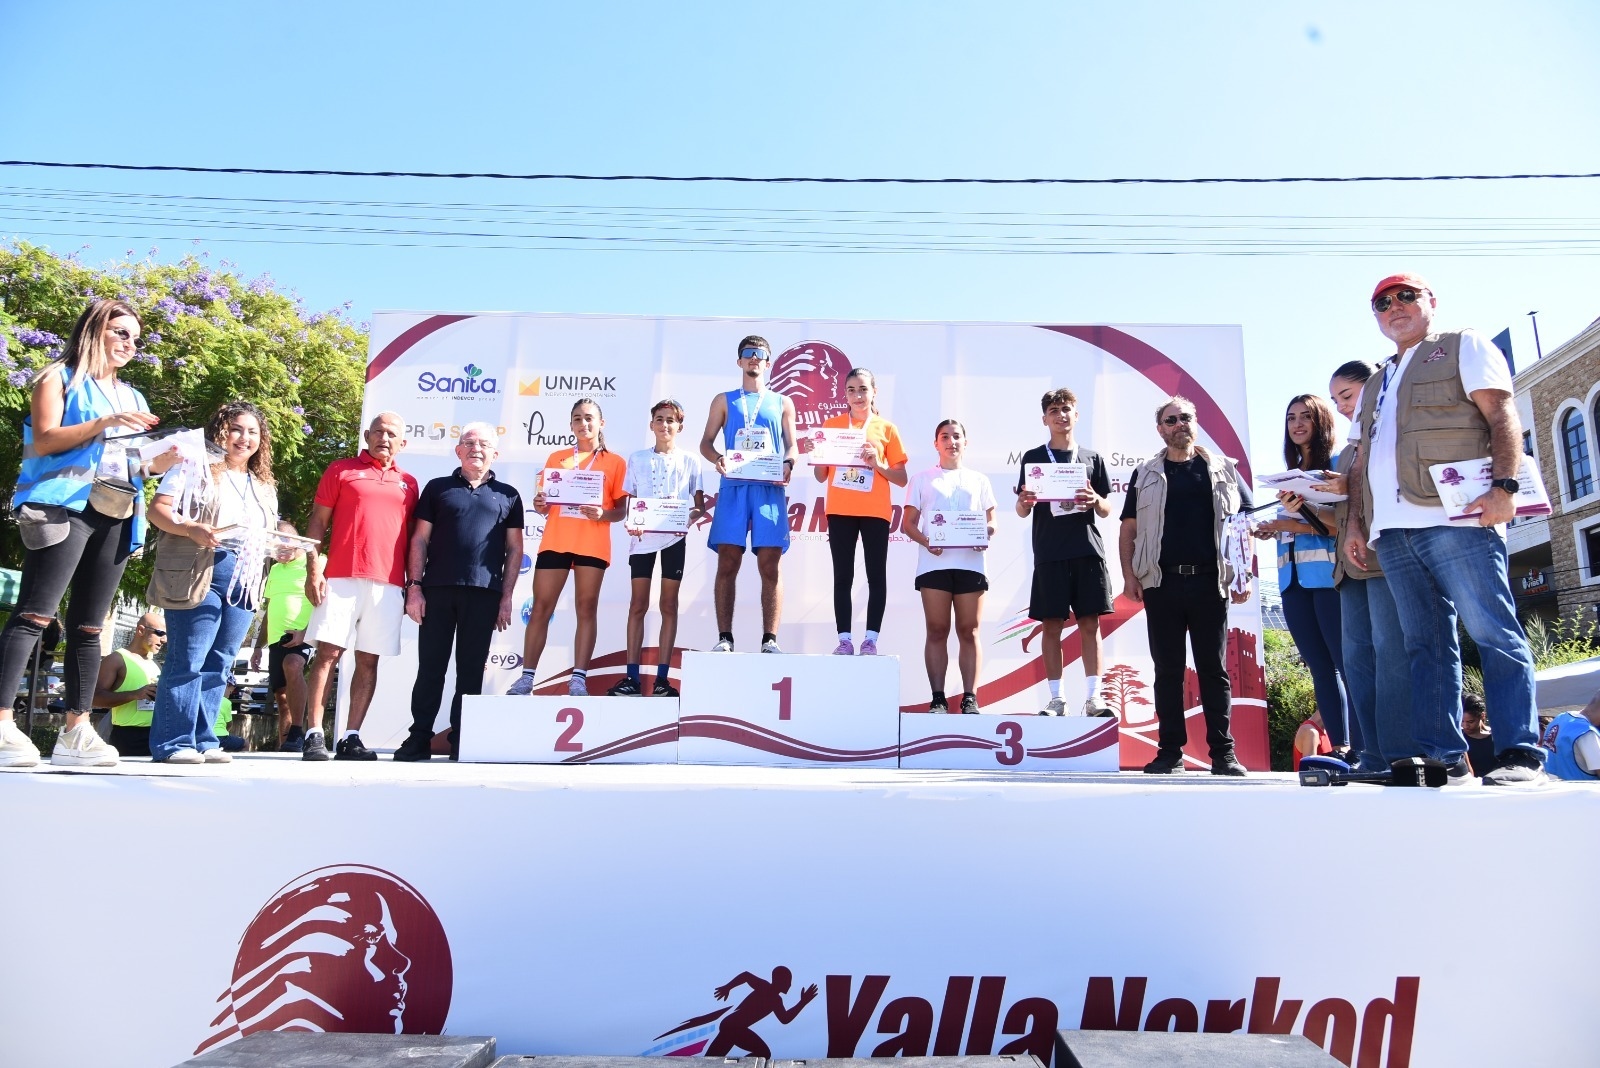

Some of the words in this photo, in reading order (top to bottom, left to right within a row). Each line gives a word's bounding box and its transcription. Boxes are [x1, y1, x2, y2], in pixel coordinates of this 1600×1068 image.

[418, 371, 496, 394] Sanita
[545, 375, 617, 391] UNIPAK
[841, 472, 866, 484] 328
[491, 654, 515, 667] eye
[771, 676, 792, 721] 1
[553, 707, 585, 752] 2
[995, 721, 1024, 766] 3
[825, 974, 1059, 1068] Yalla
